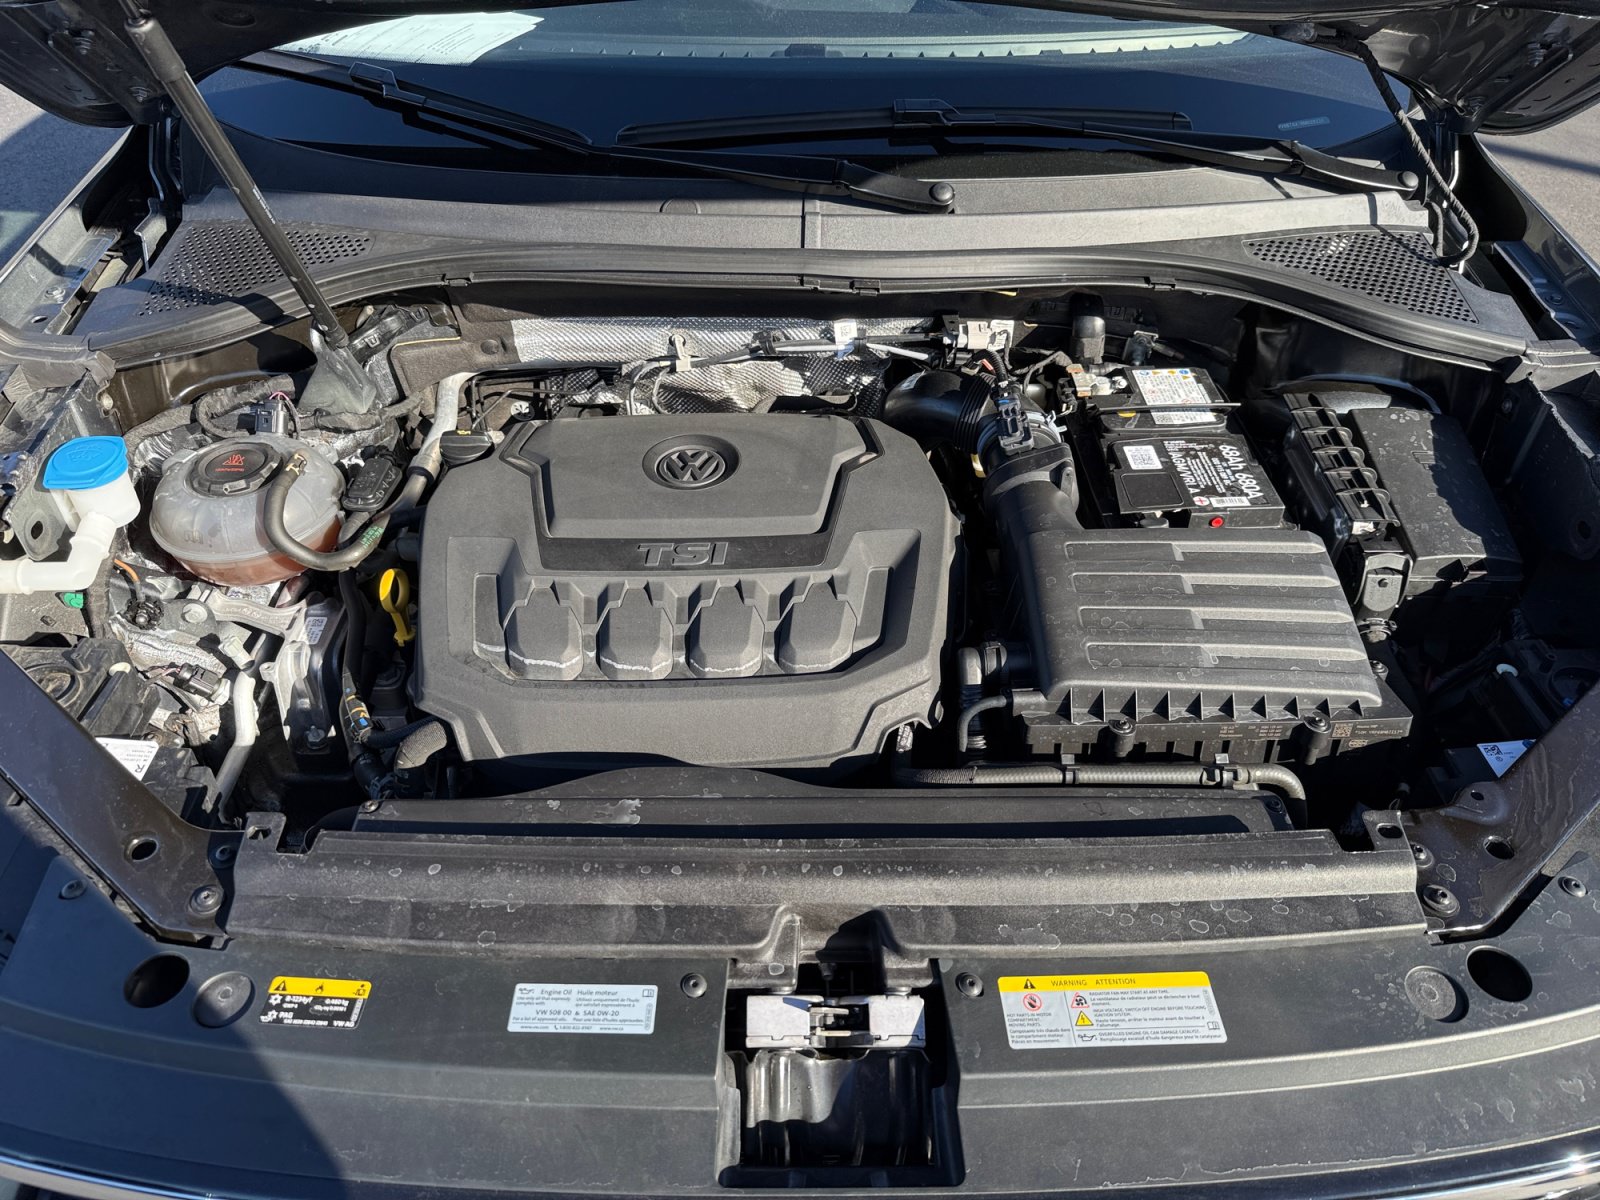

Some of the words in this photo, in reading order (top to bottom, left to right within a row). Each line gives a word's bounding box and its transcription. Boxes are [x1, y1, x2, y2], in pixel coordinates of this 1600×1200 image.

[1220, 445, 1246, 470] 68Ah
[1235, 472, 1264, 499] 680A
[637, 542, 729, 566] TSI
[1051, 979, 1087, 987] WARNING
[540, 988, 562, 996] Engine
